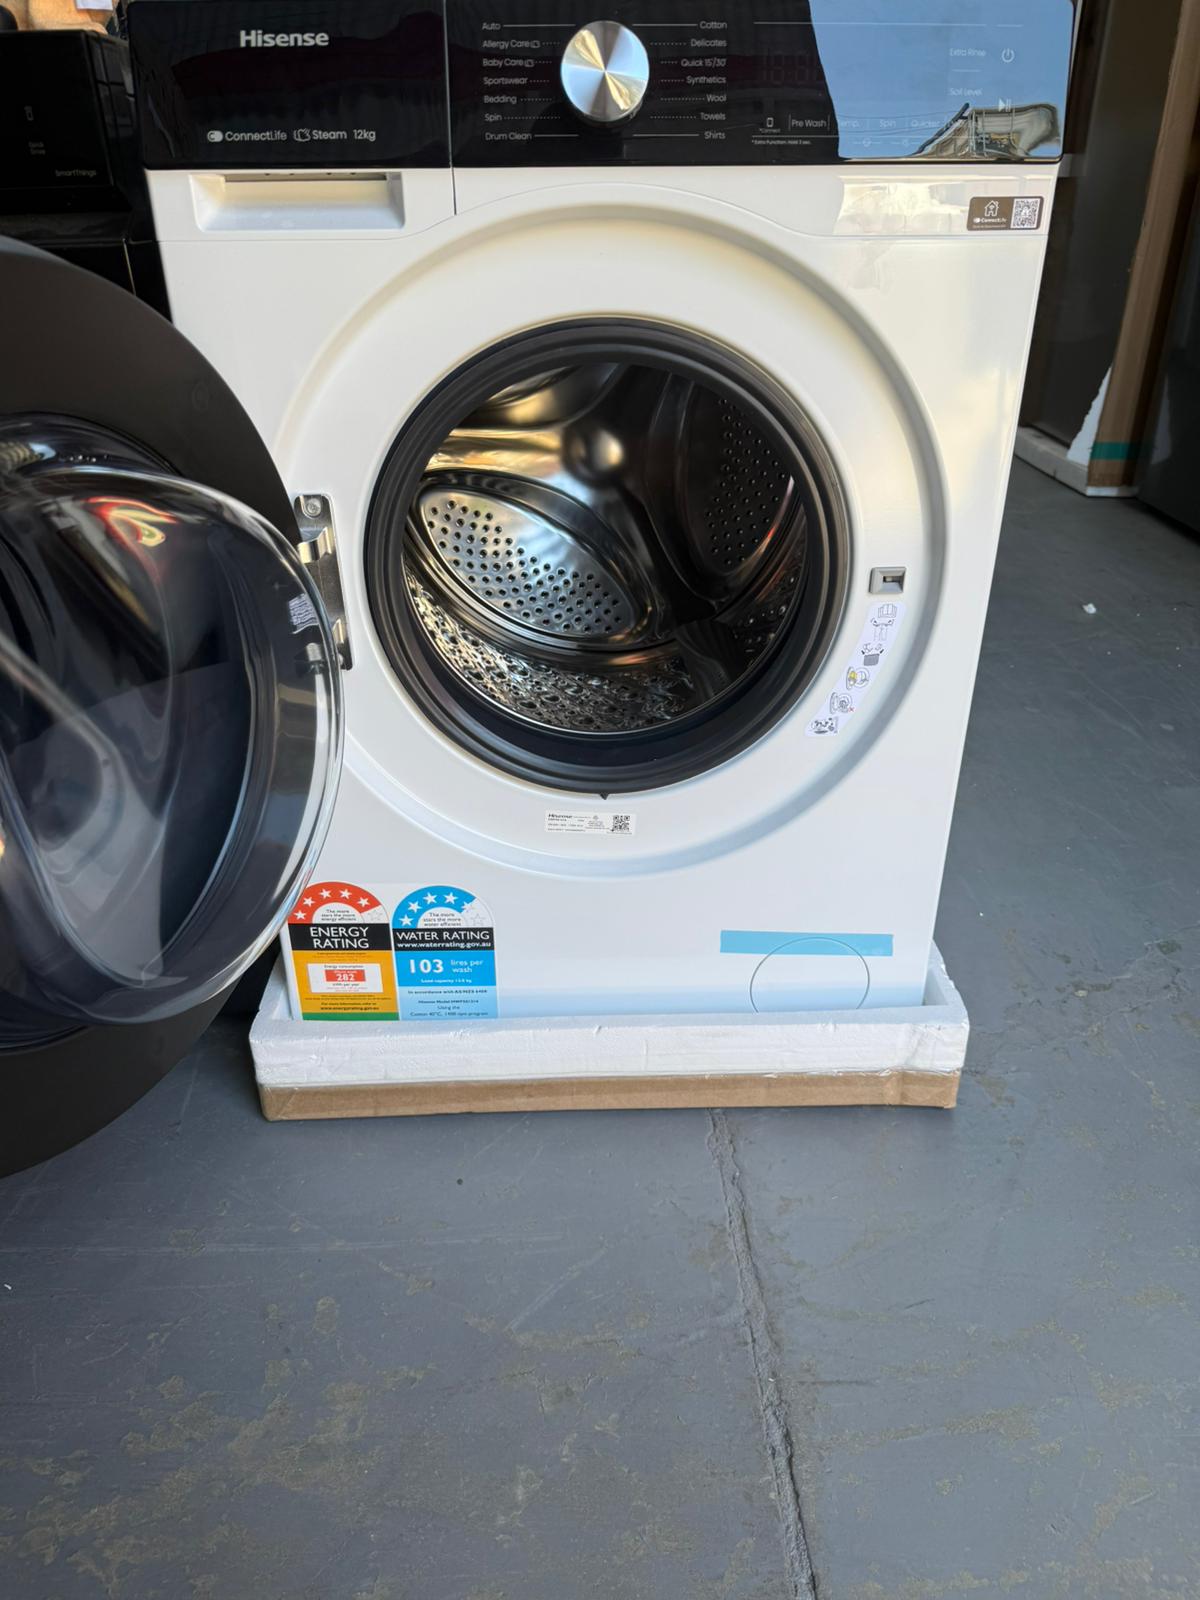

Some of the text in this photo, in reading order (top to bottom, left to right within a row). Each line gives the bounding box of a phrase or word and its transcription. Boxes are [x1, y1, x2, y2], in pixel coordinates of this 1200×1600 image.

[700, 21, 727, 29] Cotton
[240, 30, 329, 47] Hisense
[690, 39, 727, 47] Delicates
[483, 40, 530, 49] Allergy Care
[483, 59, 503, 68] Baby
[681, 59, 703, 67] Quick
[483, 77, 528, 86] Sportswear
[686, 75, 726, 86] Synthetics
[484, 96, 517, 104] Bedding
[706, 94, 727, 102] Wool
[485, 113, 502, 122] Spin
[700, 112, 726, 121] Towels
[791, 119, 826, 128] Pre Wash
[225, 129, 376, 141] ConnectLife Steam 12kg
[485, 132, 532, 140] Drum Clean
[704, 131, 726, 139] Shirts
[310, 926, 369, 937] ENERGY
[396, 930, 490, 941] WATER RATING
[313, 938, 370, 949] RATING
[397, 941, 491, 949] www.waterrating.gov.au
[409, 959, 444, 974] 103
[336, 973, 355, 981] 282
